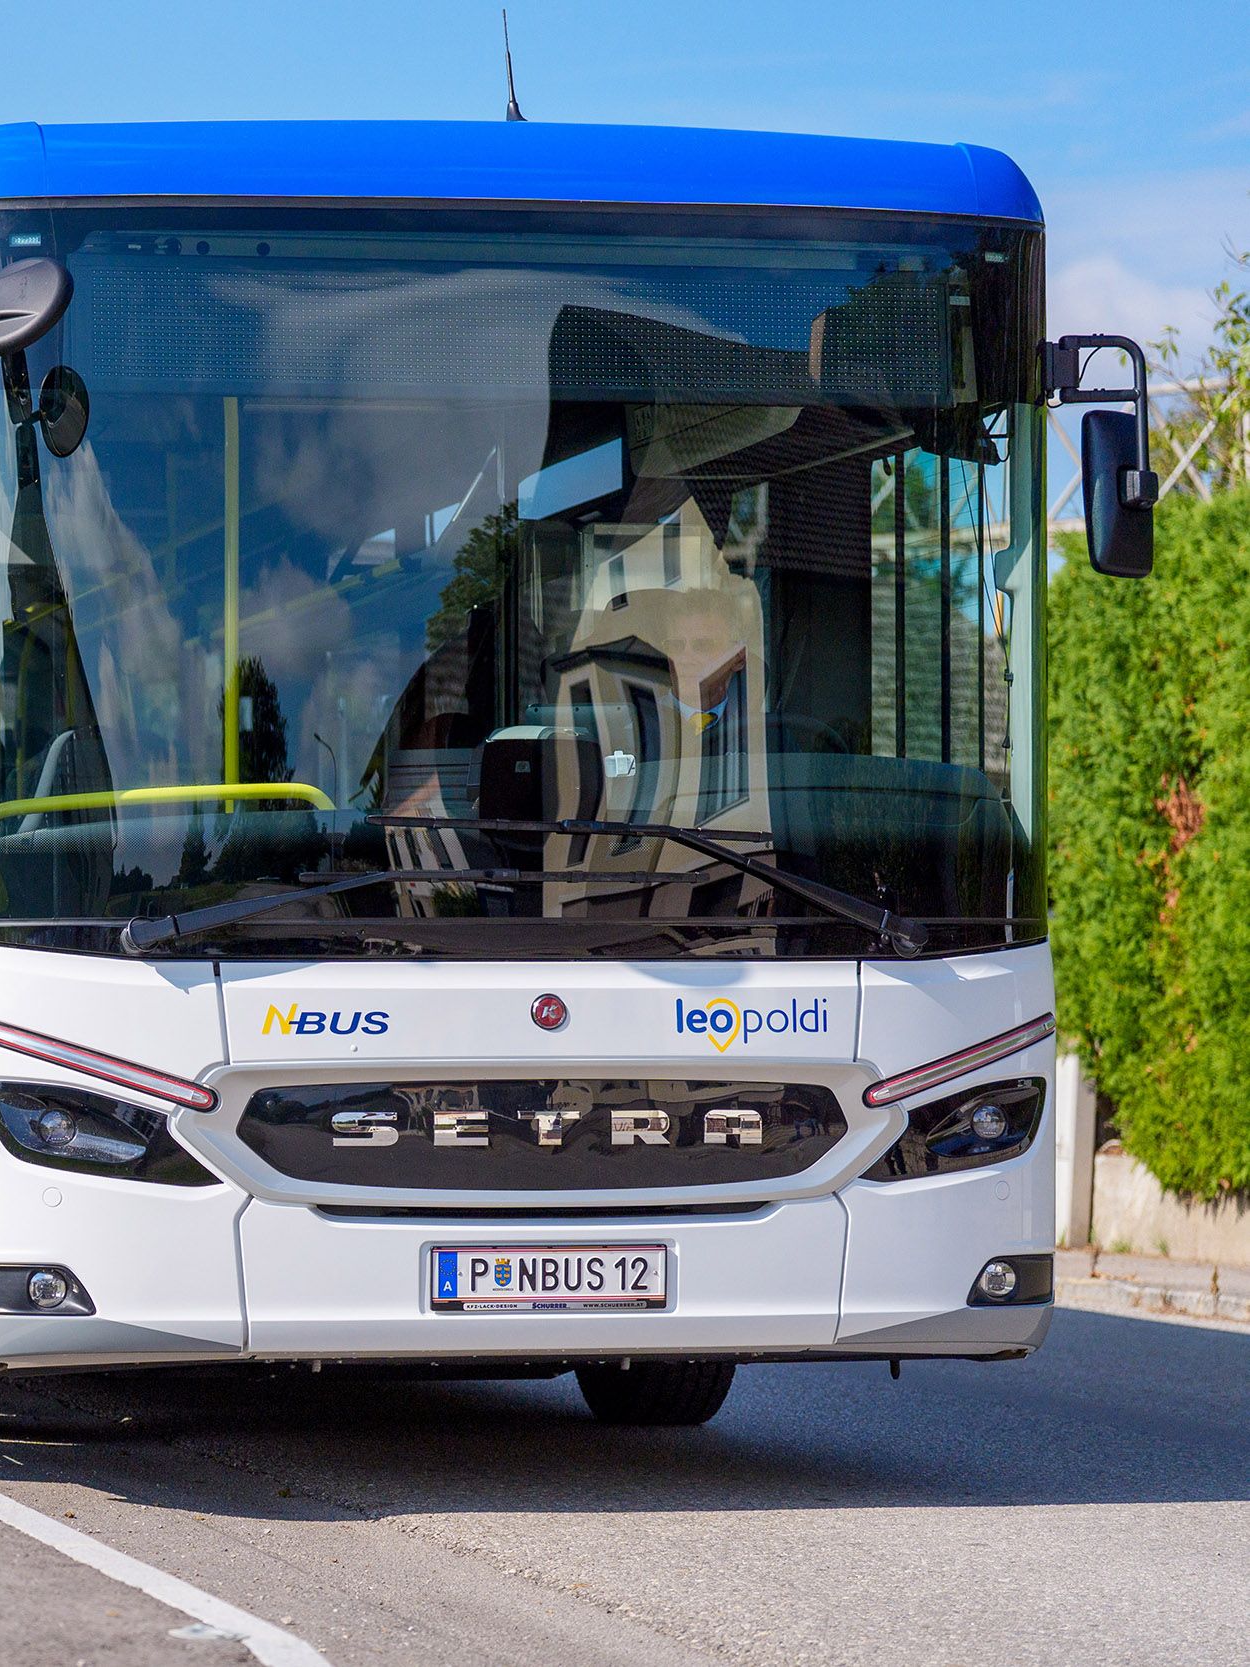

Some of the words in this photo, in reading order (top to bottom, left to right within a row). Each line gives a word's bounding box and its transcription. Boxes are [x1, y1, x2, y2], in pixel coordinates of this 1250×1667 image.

[261, 1003, 390, 1035] N-BUS
[676, 998, 828, 1045] leopoldi
[331, 1108, 763, 1147] SETRA
[443, 1281, 453, 1292] A
[470, 1258, 489, 1292] P
[518, 1257, 604, 1292] NBUS
[614, 1257, 648, 1291] 12
